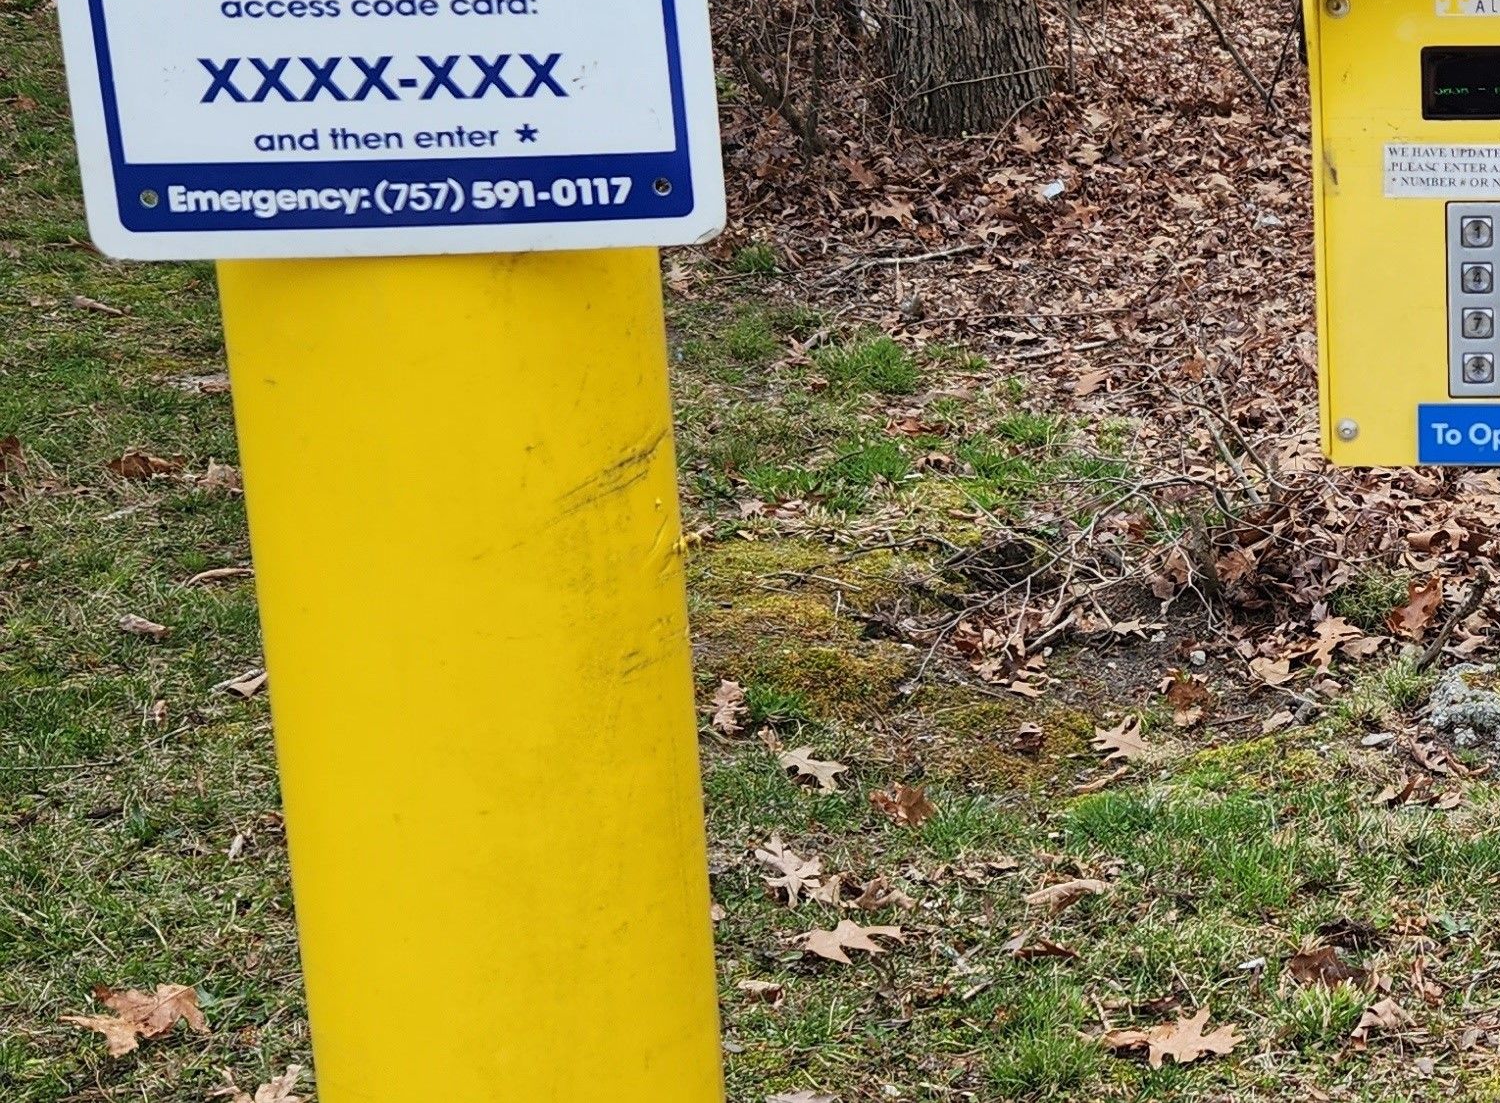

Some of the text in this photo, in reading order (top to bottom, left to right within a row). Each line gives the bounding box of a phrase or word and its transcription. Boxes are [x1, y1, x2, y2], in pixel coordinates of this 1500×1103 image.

[196, 52, 570, 103] XXXX-XXX
[254, 128, 320, 152] and
[328, 127, 404, 151] then
[415, 126, 499, 149] enter
[1388, 147, 1409, 158] WE
[1412, 147, 1447, 158] HAVE
[1443, 162, 1487, 173] ENTER
[1400, 176, 1457, 187] NUMBER
[1469, 177, 1489, 188] OR
[166, 176, 633, 219] Emergency: (757) 591-0117
[1473, 316, 1483, 331] 7
[1431, 423, 1463, 446] To
